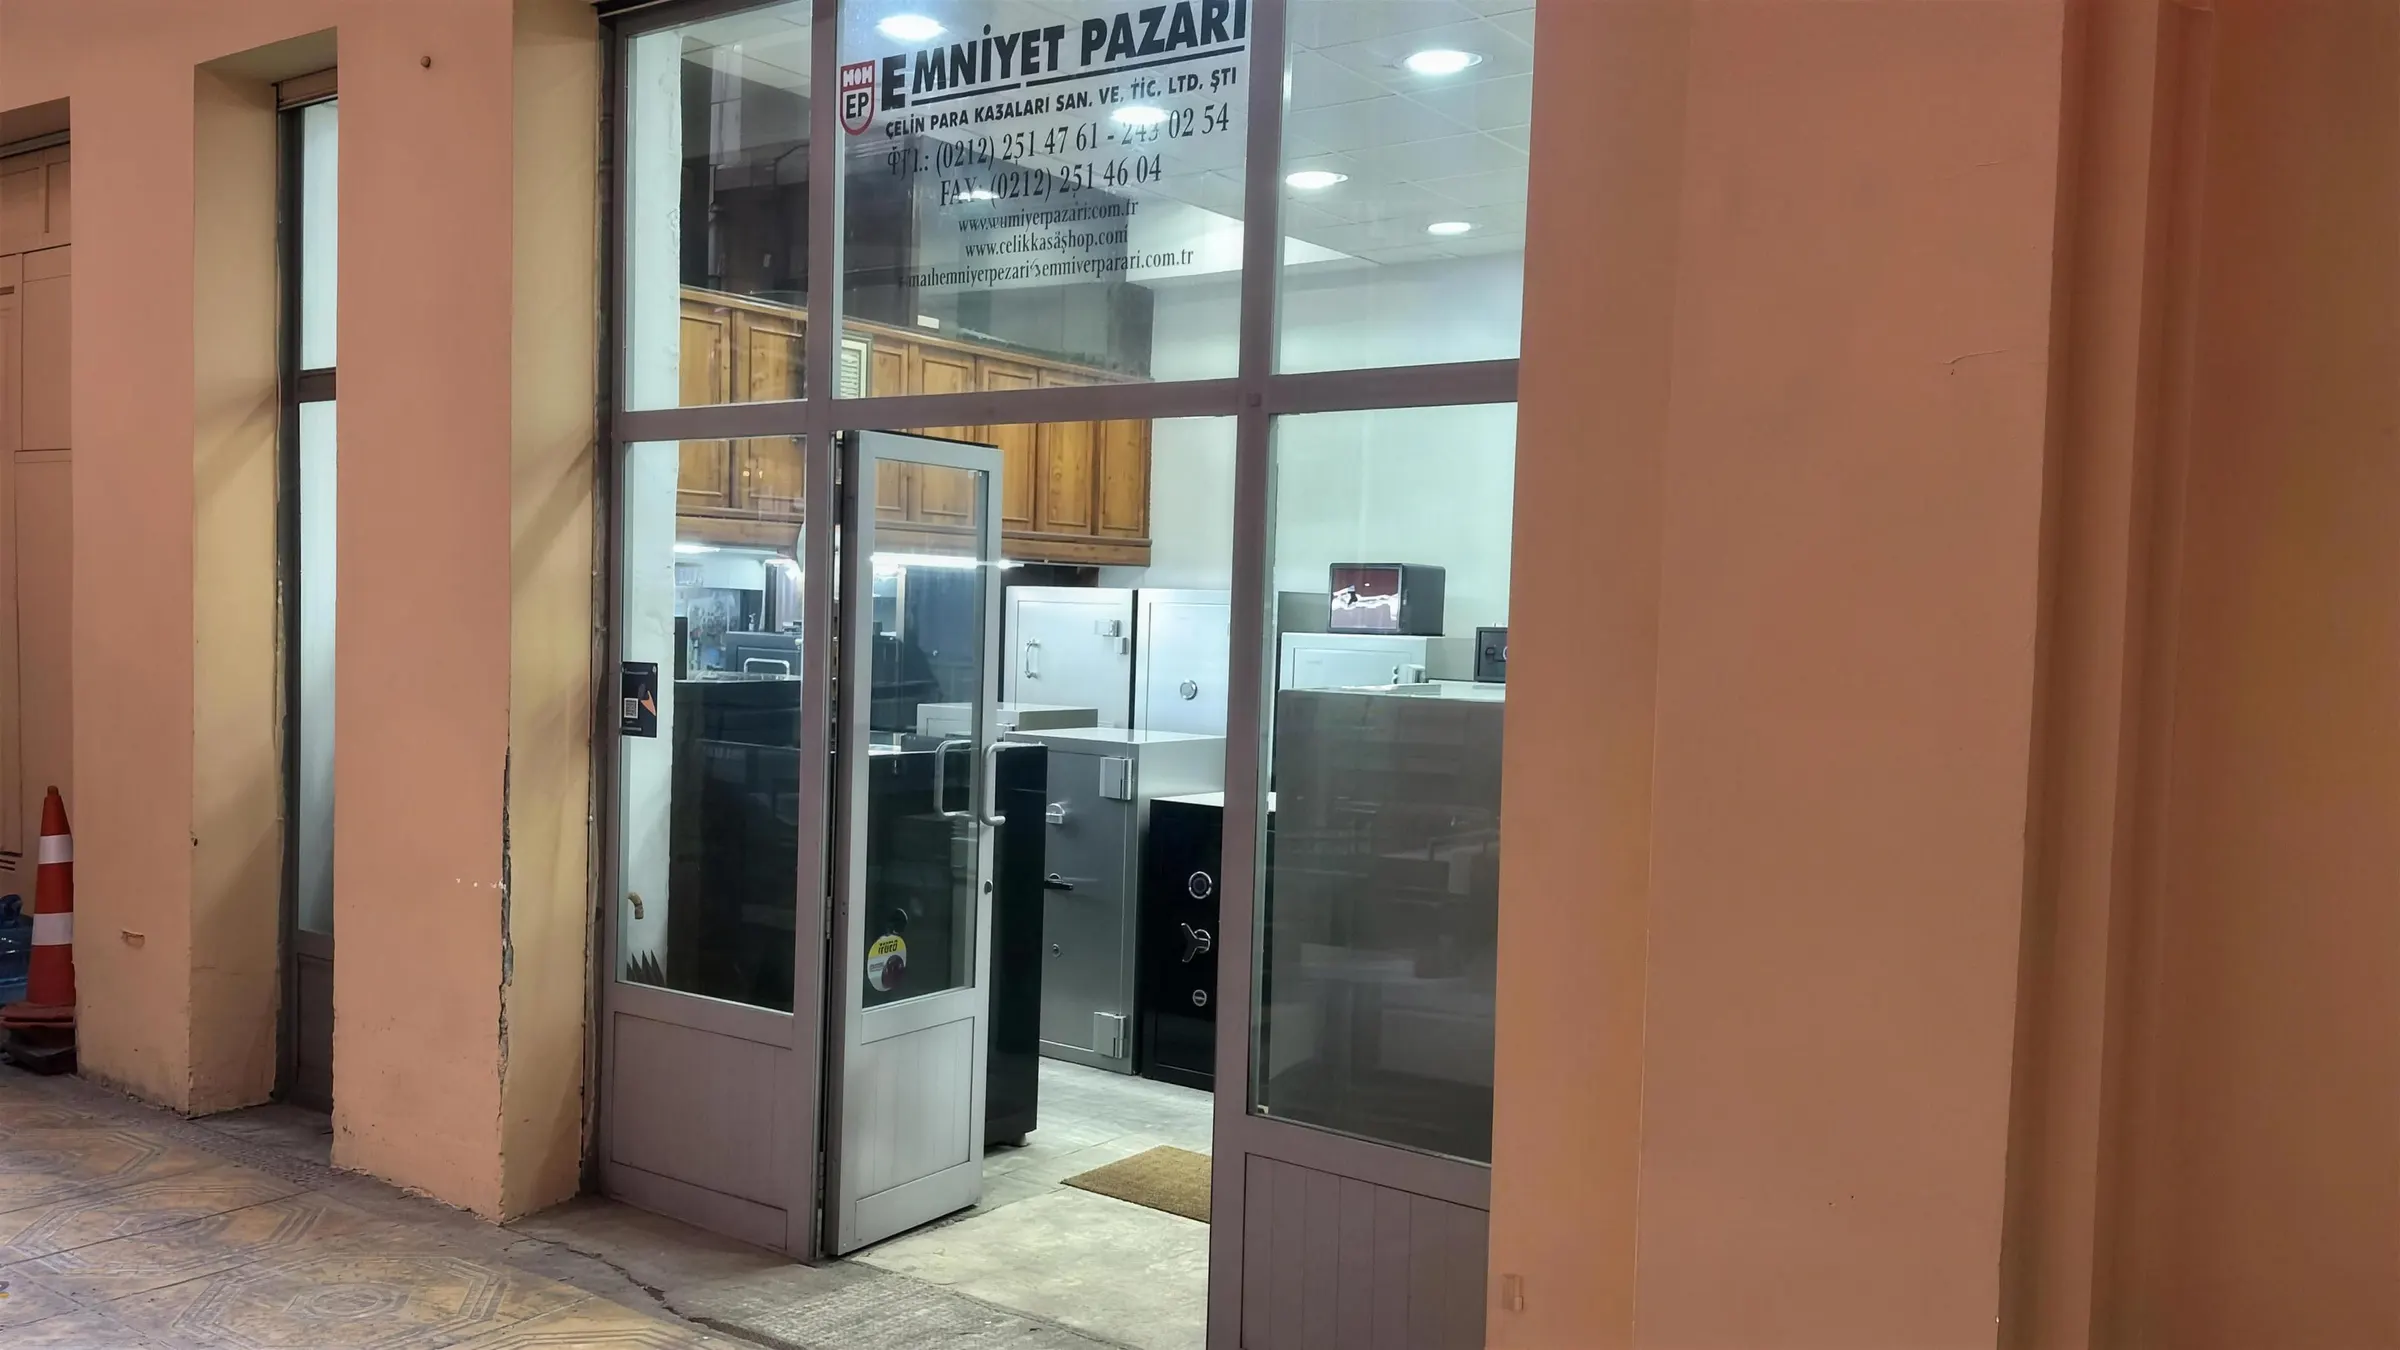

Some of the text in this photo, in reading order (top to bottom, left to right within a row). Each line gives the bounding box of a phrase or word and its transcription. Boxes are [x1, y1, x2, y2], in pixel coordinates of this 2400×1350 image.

[1080, 0, 1247, 66] PAZARI
[846, 92, 869, 119] EP
[930, 111, 969, 131] PARA
[936, 136, 995, 177] (0212)
[1002, 130, 1035, 163] 251
[1044, 125, 1069, 155] 47
[1076, 122, 1098, 151] 61
[1168, 107, 1194, 139] 02
[1201, 102, 1230, 135] 54
[989, 167, 1052, 210] (0212)
[1059, 162, 1094, 196] 251
[1103, 156, 1128, 187] 46
[1136, 153, 1162, 184] 04
